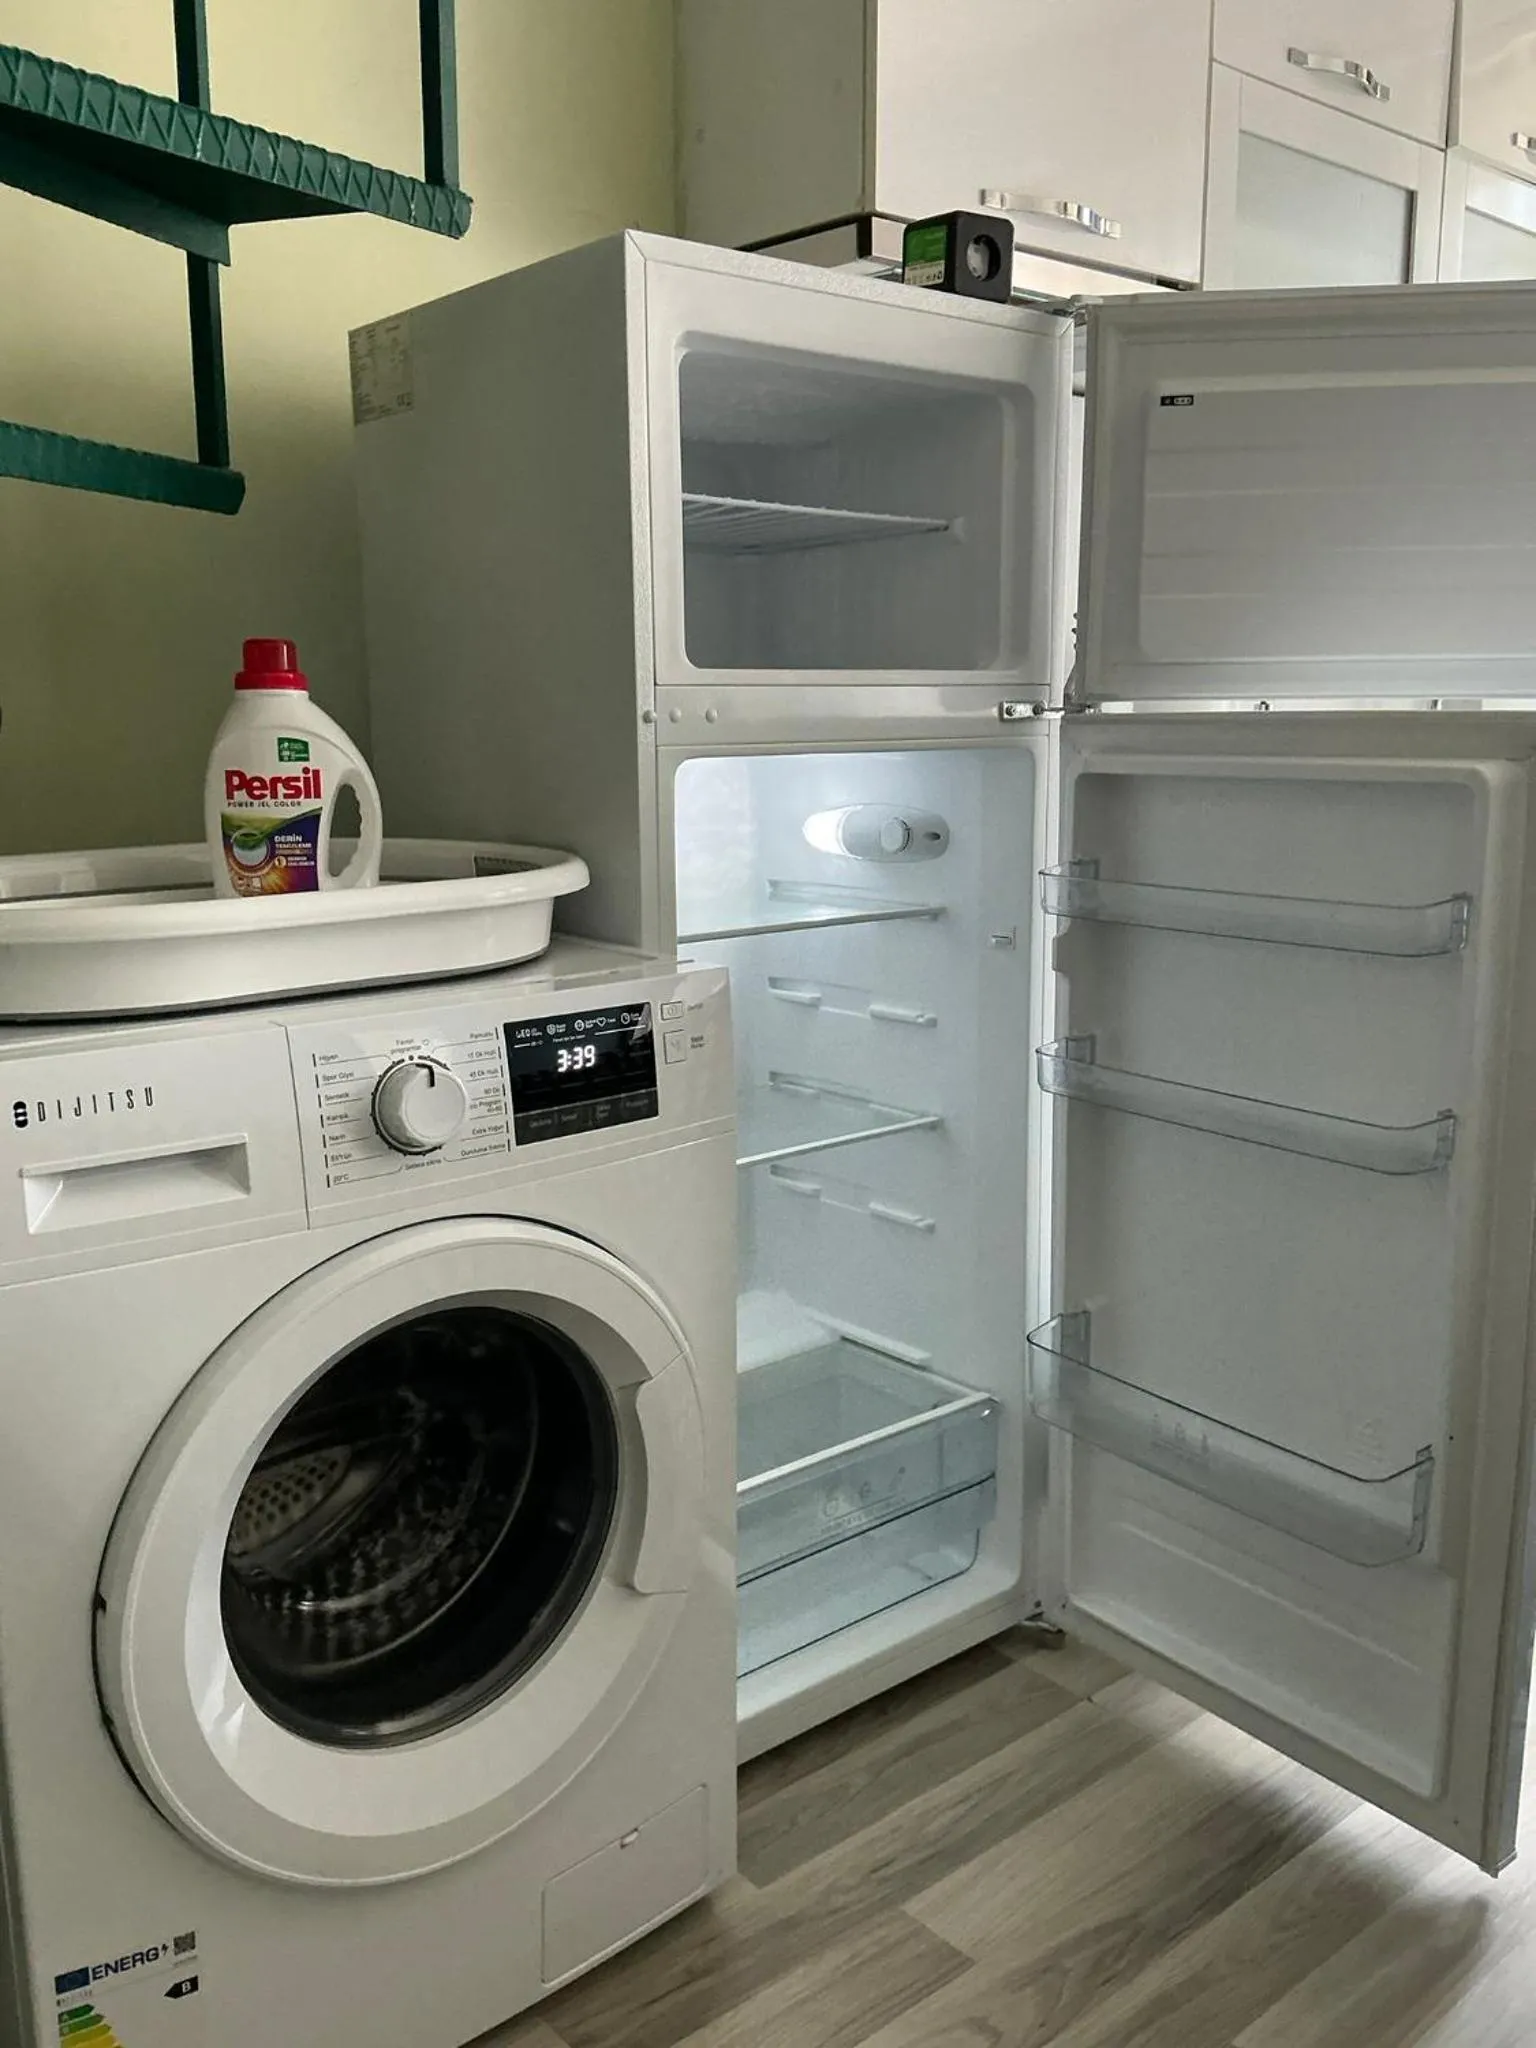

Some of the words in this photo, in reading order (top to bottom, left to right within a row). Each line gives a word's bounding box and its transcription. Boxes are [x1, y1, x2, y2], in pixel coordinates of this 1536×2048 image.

[224, 767, 321, 800] Persil
[557, 1045, 596, 1073] 3:39
[37, 1086, 154, 1122] DIJITSU
[92, 1947, 160, 1981] ENERG
[181, 1980, 192, 1993] B
